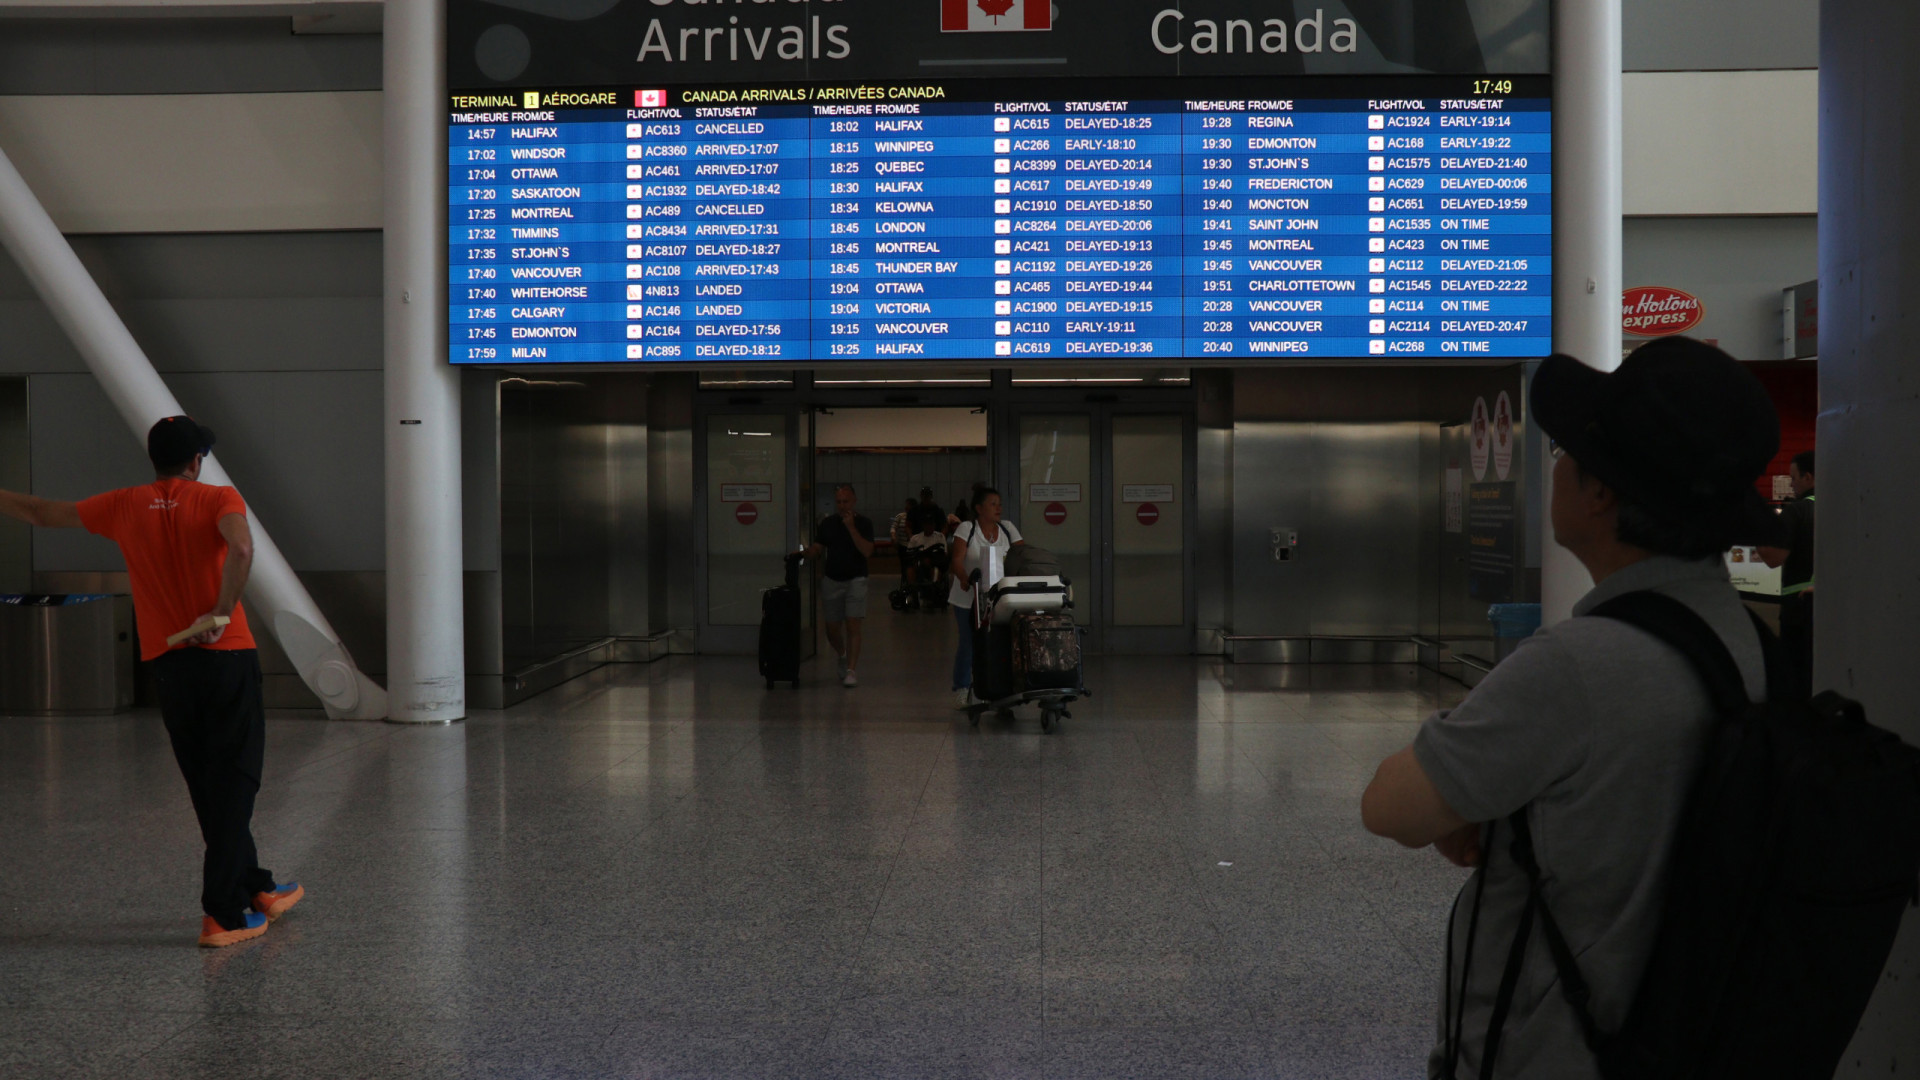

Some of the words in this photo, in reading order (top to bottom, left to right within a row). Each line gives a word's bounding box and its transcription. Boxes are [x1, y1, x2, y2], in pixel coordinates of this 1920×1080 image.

[1151, 8, 1359, 55] Canada
[636, 15, 851, 62] Arrivals
[682, 90, 738, 102] CANADA
[741, 89, 806, 101] ARRIVALS
[817, 85, 885, 100] ARRIVÉES
[888, 86, 945, 99] CANADA
[1473, 80, 1512, 94] 17:49
[452, 96, 517, 108] TERMINAL
[542, 91, 617, 106] AÉROGARE
[1185, 101, 1245, 110] TIME/HEURE
[1248, 100, 1293, 110] FROM/DE
[1369, 100, 1425, 109] FLIGHT/VOL
[1440, 99, 1503, 109] STATUS/ÉTAT
[452, 112, 509, 123] TIME/HEURE
[512, 111, 555, 121] FROM/DE
[627, 109, 682, 119] FLIGHT/VOL
[696, 106, 758, 117] STATUS/ÉTAT
[830, 122, 858, 132] 18:02
[876, 120, 923, 131] HALIFAX
[1014, 119, 1049, 129] AC615
[1066, 118, 1152, 129] DELAYED-18:25
[1203, 117, 1231, 128] 19:28
[1248, 117, 1293, 127] REGINA
[1388, 117, 1430, 127] AC1924
[1441, 116, 1510, 126] EARLY-19:14
[469, 129, 495, 139] 14:57
[512, 127, 557, 138] HALIFAX
[646, 125, 680, 135] AC613
[696, 123, 764, 134] CANCELLED
[830, 142, 859, 153] 18:15
[875, 141, 933, 152] WINNIPEG
[1014, 140, 1049, 150] AC266
[1066, 139, 1135, 150] EARLY-18:10
[1203, 139, 1231, 149] 19:30
[1249, 138, 1316, 149] EDMONTON
[1388, 138, 1424, 148] AC168
[1441, 138, 1510, 148] EARLY-19:22
[468, 150, 495, 160] 17:02
[511, 148, 565, 159] WINDSOR
[645, 145, 687, 156] AC8360
[696, 144, 778, 155] ARRIVED-17:07
[831, 162, 859, 173] 18:25
[875, 162, 924, 175] QUEBEC
[1014, 160, 1056, 170] AC8399
[1066, 160, 1152, 170] DELAYED-20:14
[1203, 159, 1232, 169] 19:30
[1388, 158, 1430, 168] AC1575
[1441, 158, 1527, 168] DELAYED-21:40
[468, 170, 495, 180] 17:04
[512, 168, 558, 179] OTTAWA
[646, 166, 680, 176] AC461
[696, 164, 778, 175] ARRIVED-17:07
[1203, 179, 1232, 189] 19:40
[1249, 179, 1332, 189] FREDERICTON
[1388, 179, 1424, 189] AC629
[1441, 178, 1527, 189] DELAYED-00:06
[468, 189, 496, 200] 17:20
[512, 187, 580, 199] SASKATOON
[645, 186, 687, 196] AC1932
[696, 184, 780, 195] DELAYED-18:42
[831, 203, 859, 213] 18:34
[876, 202, 933, 213] KELOWNA
[1014, 201, 1056, 211] AC1910
[1066, 200, 1152, 210] DELAYED-18:50
[1203, 200, 1232, 210] 19:40
[1249, 199, 1308, 209] MONCTON
[1388, 199, 1424, 209] AC651
[1441, 199, 1527, 209] DELAYED-19:59
[831, 223, 859, 233] 18:45
[876, 222, 925, 233] LONDON
[1014, 221, 1056, 231] AC8264
[1066, 220, 1152, 231] DELAYED-20:06
[1203, 220, 1232, 230] 19:41
[1249, 219, 1283, 230] SAINT
[1286, 219, 1318, 230] JOHN
[1388, 219, 1431, 229] AC1535
[1441, 219, 1458, 229] ON
[1461, 219, 1489, 229] TIME
[468, 229, 495, 239] 17:32
[511, 228, 559, 238] TIMMINS
[645, 226, 687, 236] AC8434
[696, 224, 778, 235] ARRIVED-17:31
[468, 249, 496, 259] 17:35
[646, 245, 686, 256] AC8107
[696, 244, 780, 255] DELAYED-18:27
[831, 243, 859, 253] 18:45
[876, 242, 940, 253] MONTREAL
[1014, 241, 1050, 251] AC421
[1066, 240, 1152, 251] DELAYED-19:13
[1204, 240, 1232, 250] 19:45
[1249, 240, 1314, 250] MONTREAL
[1388, 240, 1424, 250] AC423
[1441, 240, 1458, 249] ON
[1461, 240, 1489, 250] TIME
[468, 269, 496, 279] 17:40
[511, 267, 581, 278] VANCOUVER
[646, 266, 680, 276] AC108
[696, 264, 779, 275] ARRIVED-17:43
[831, 263, 859, 273] 18:45
[876, 262, 932, 273] THUNDER
[936, 262, 958, 273] BAY
[1014, 261, 1056, 272] AC1192
[1066, 261, 1152, 272] DELAYED-19:26
[469, 289, 496, 299] 17:40
[512, 287, 587, 298] WHITEHORSE
[646, 286, 679, 296] 4N813
[696, 285, 742, 295] LANDED
[831, 284, 859, 294] 19:04
[876, 283, 924, 293] OTTAWA
[1014, 282, 1050, 292] AC465
[1066, 281, 1152, 291] DELAYED-19:44
[1204, 281, 1232, 291] 19:51
[1249, 280, 1355, 291] CHARLOTTETOWN
[1389, 280, 1431, 290] AC1545
[1442, 280, 1527, 290] DELAYED-22:22
[831, 304, 859, 314] 19:04
[876, 303, 931, 313] VICTORIA
[1014, 302, 1057, 312] AC1900
[1066, 301, 1153, 312] DELAYED-19:15
[1636, 293, 1699, 314] Hortons
[469, 308, 496, 318] 17:45
[512, 307, 565, 318] CALGARY
[646, 306, 680, 316] AC146
[696, 305, 742, 315] LANDED
[1204, 322, 1232, 332] 20:28
[1249, 321, 1322, 331] VANCOUVER
[1389, 321, 1430, 331] AC2114
[1442, 321, 1527, 331] DELAYED-20:47
[1623, 311, 1687, 329] express
[469, 328, 496, 338] 17:45
[512, 327, 576, 338] EDMONTON
[646, 326, 680, 336] AC164
[696, 325, 780, 336] DELAYED-17:56
[831, 324, 859, 334] 19:15
[876, 323, 948, 334] VANCOUVER
[1015, 323, 1050, 332] AC110
[1066, 322, 1135, 332] EARLY-19:11
[469, 348, 496, 358] 17:59
[512, 348, 546, 358] MILAN
[646, 346, 681, 356] AC895
[696, 345, 780, 355] DELAYED-18:12
[1203, 342, 1232, 352] 20:40
[1249, 342, 1308, 352] WINNIPEG
[1389, 342, 1424, 351] AC268
[1441, 342, 1458, 351] ON
[1462, 342, 1489, 351] TIME
